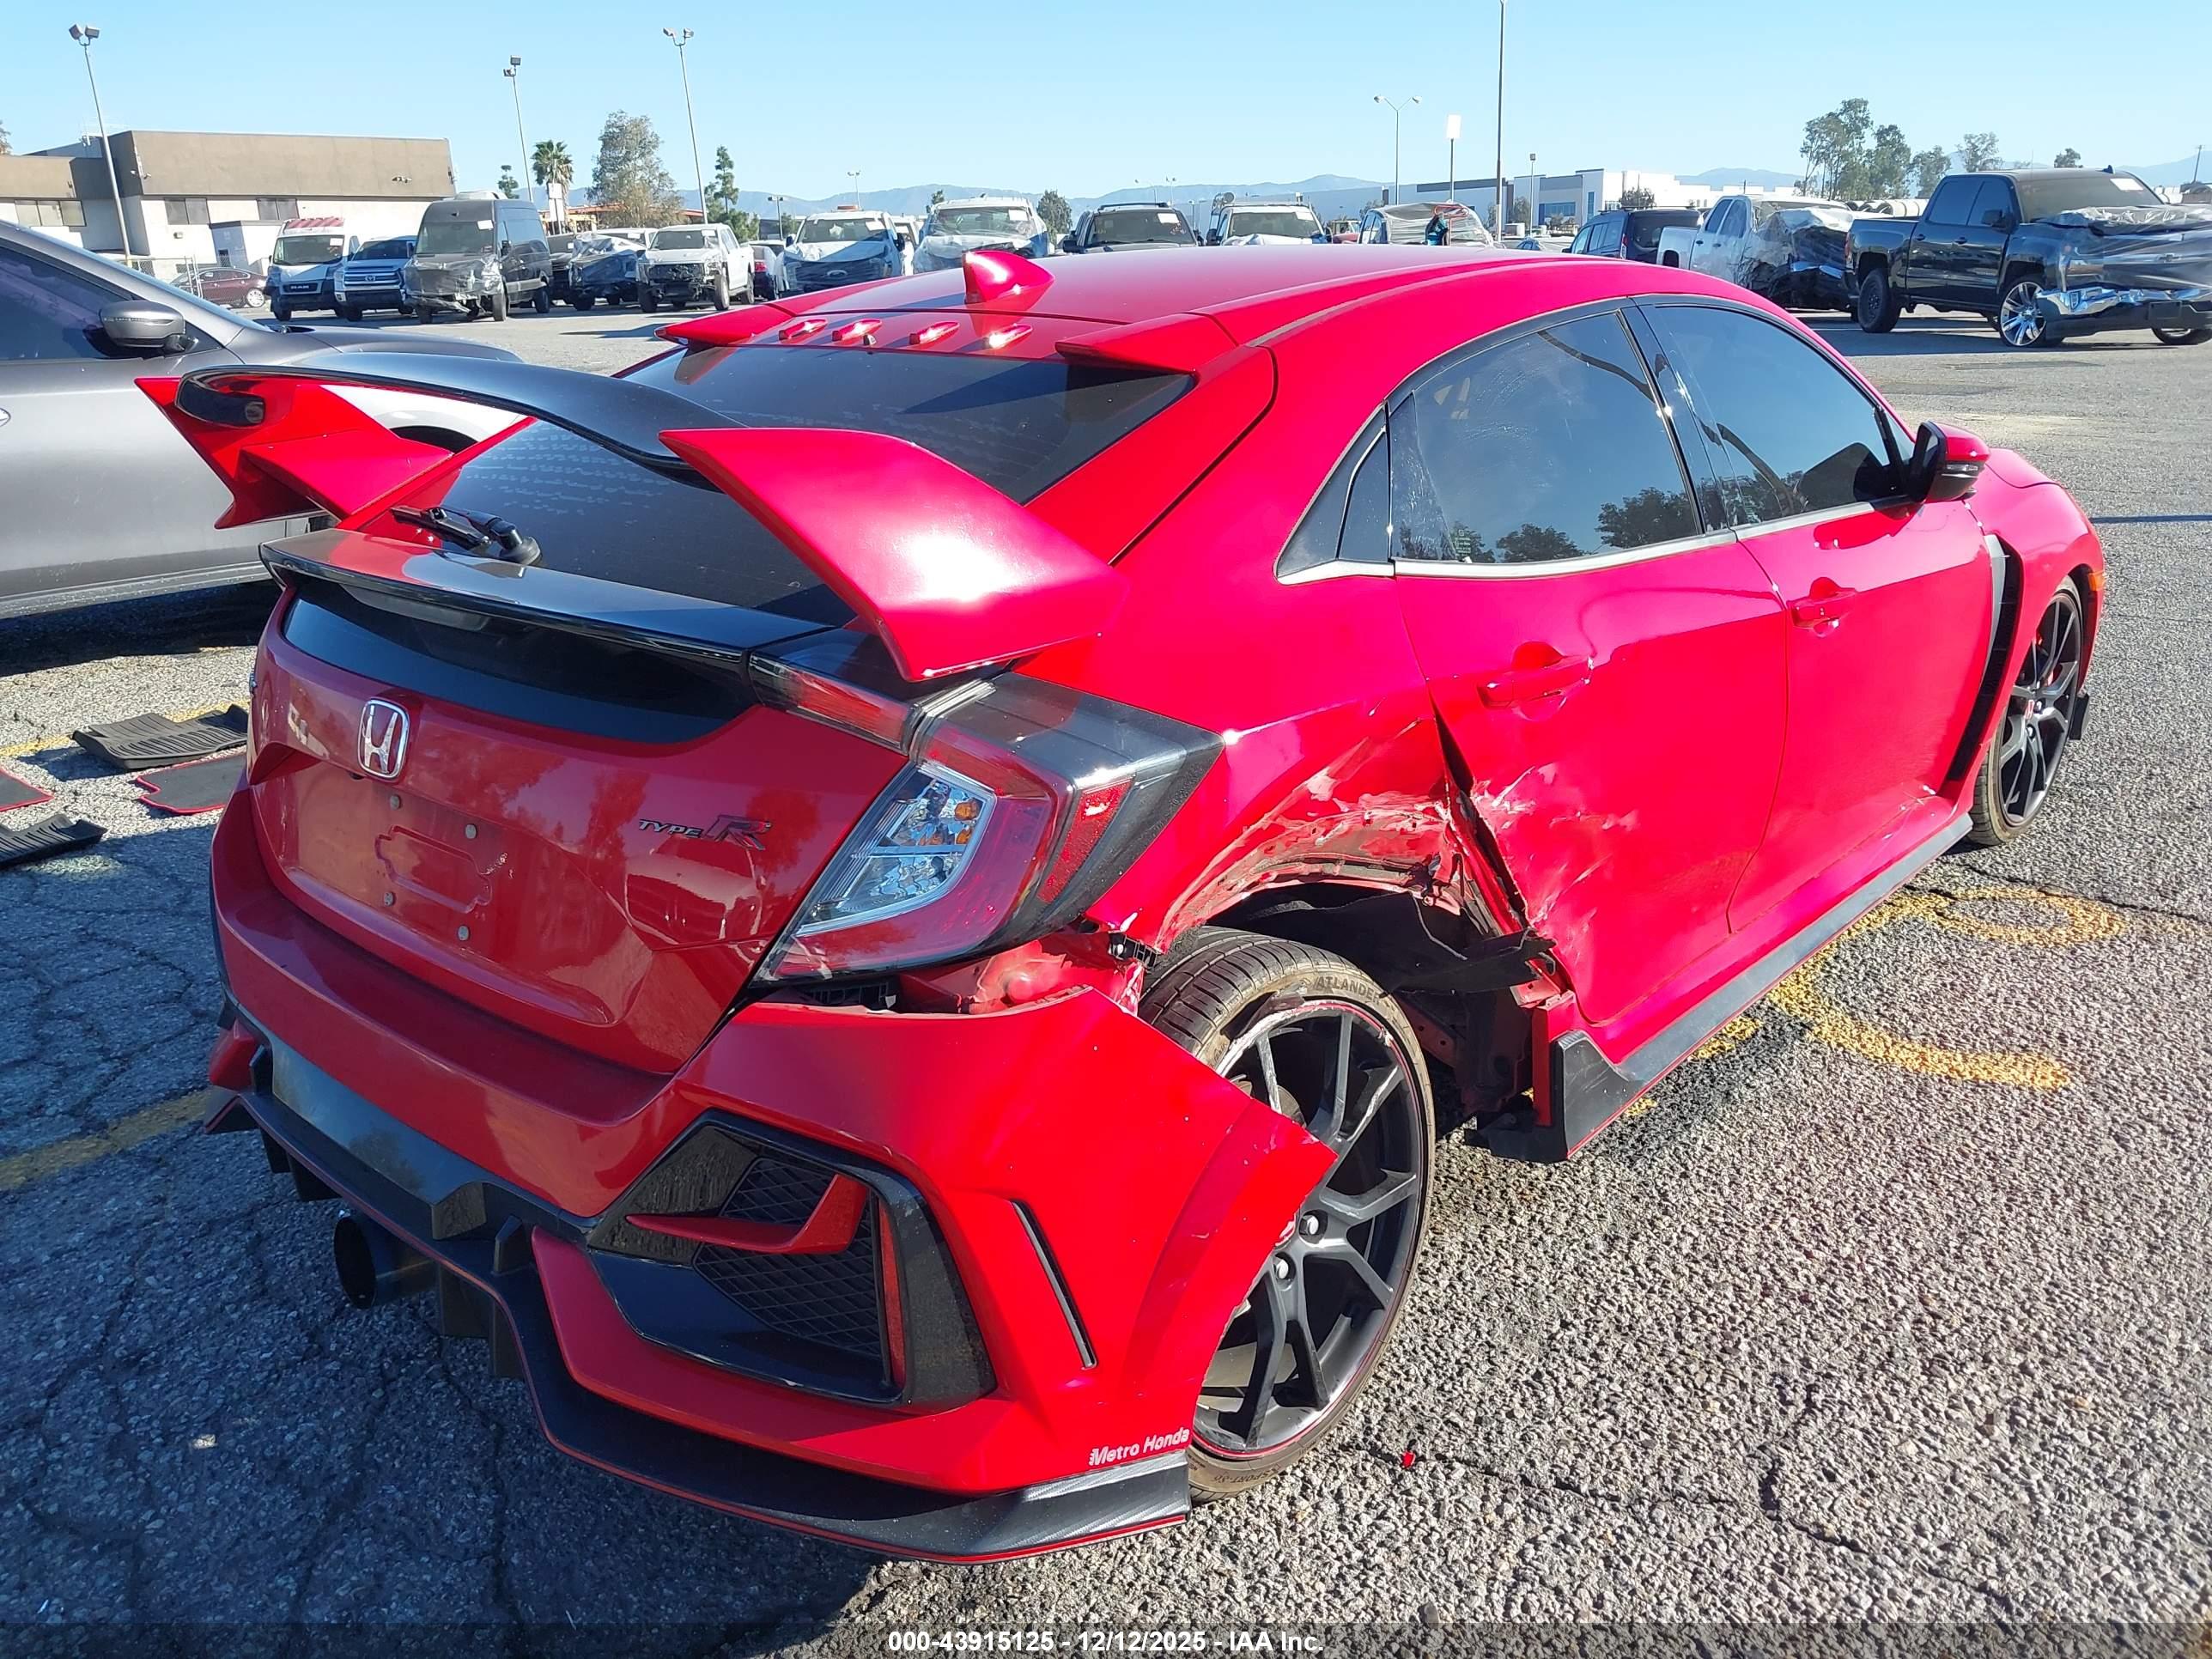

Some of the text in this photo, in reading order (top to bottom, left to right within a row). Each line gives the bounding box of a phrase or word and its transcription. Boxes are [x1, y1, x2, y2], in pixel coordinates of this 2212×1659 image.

[639, 814, 772, 851] TYPE R
[1088, 1426, 1190, 1466] Metro Honda
